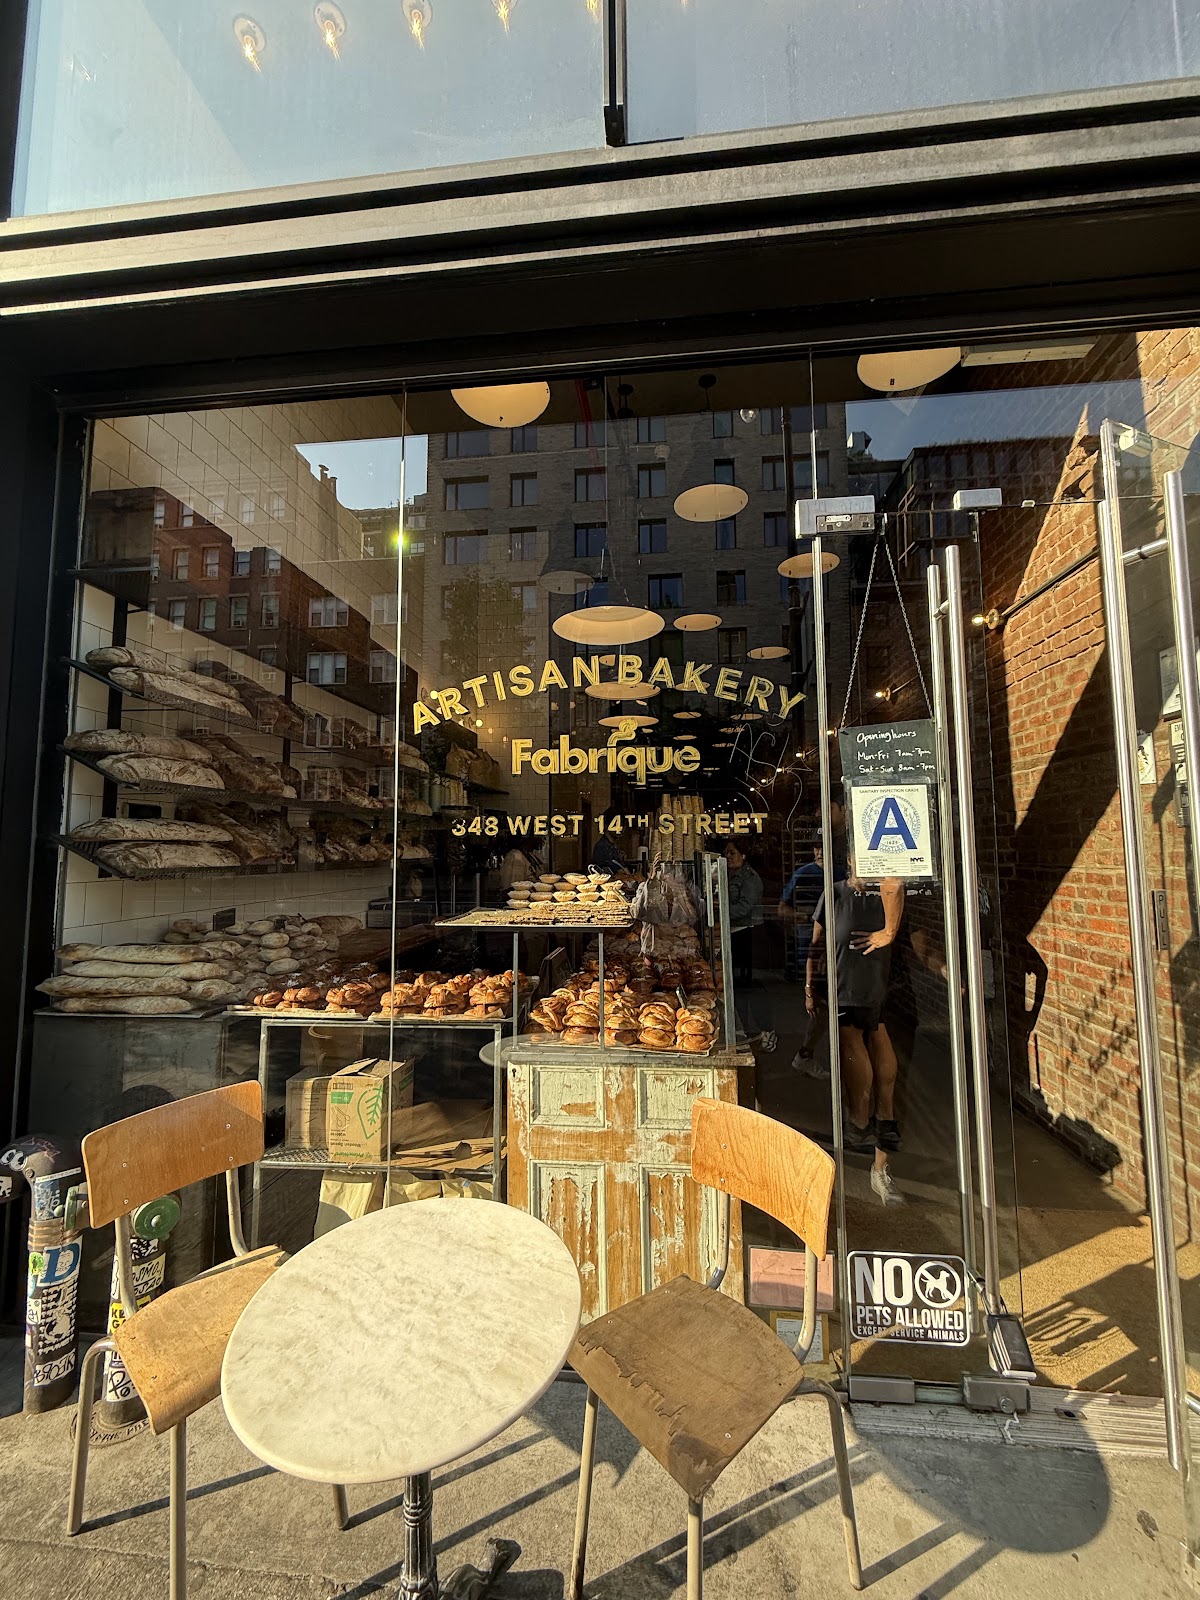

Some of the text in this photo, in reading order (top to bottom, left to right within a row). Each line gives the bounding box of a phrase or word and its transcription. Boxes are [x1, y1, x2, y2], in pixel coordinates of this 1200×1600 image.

[412, 655, 807, 735] ARTISAN BAKERY
[856, 728, 917, 747] Opening hours
[511, 718, 701, 786] Fabrique
[857, 749, 890, 761] Mon-Fri
[451, 815, 499, 837] 348
[507, 814, 584, 836] WEST
[658, 812, 768, 836] STREET
[867, 797, 918, 850] A
[854, 1256, 914, 1306] NO
[856, 1305, 965, 1330] PETS ALLOWED
[890, 1327, 925, 1339] SERVICE
[927, 1329, 965, 1341] ANIMALS
